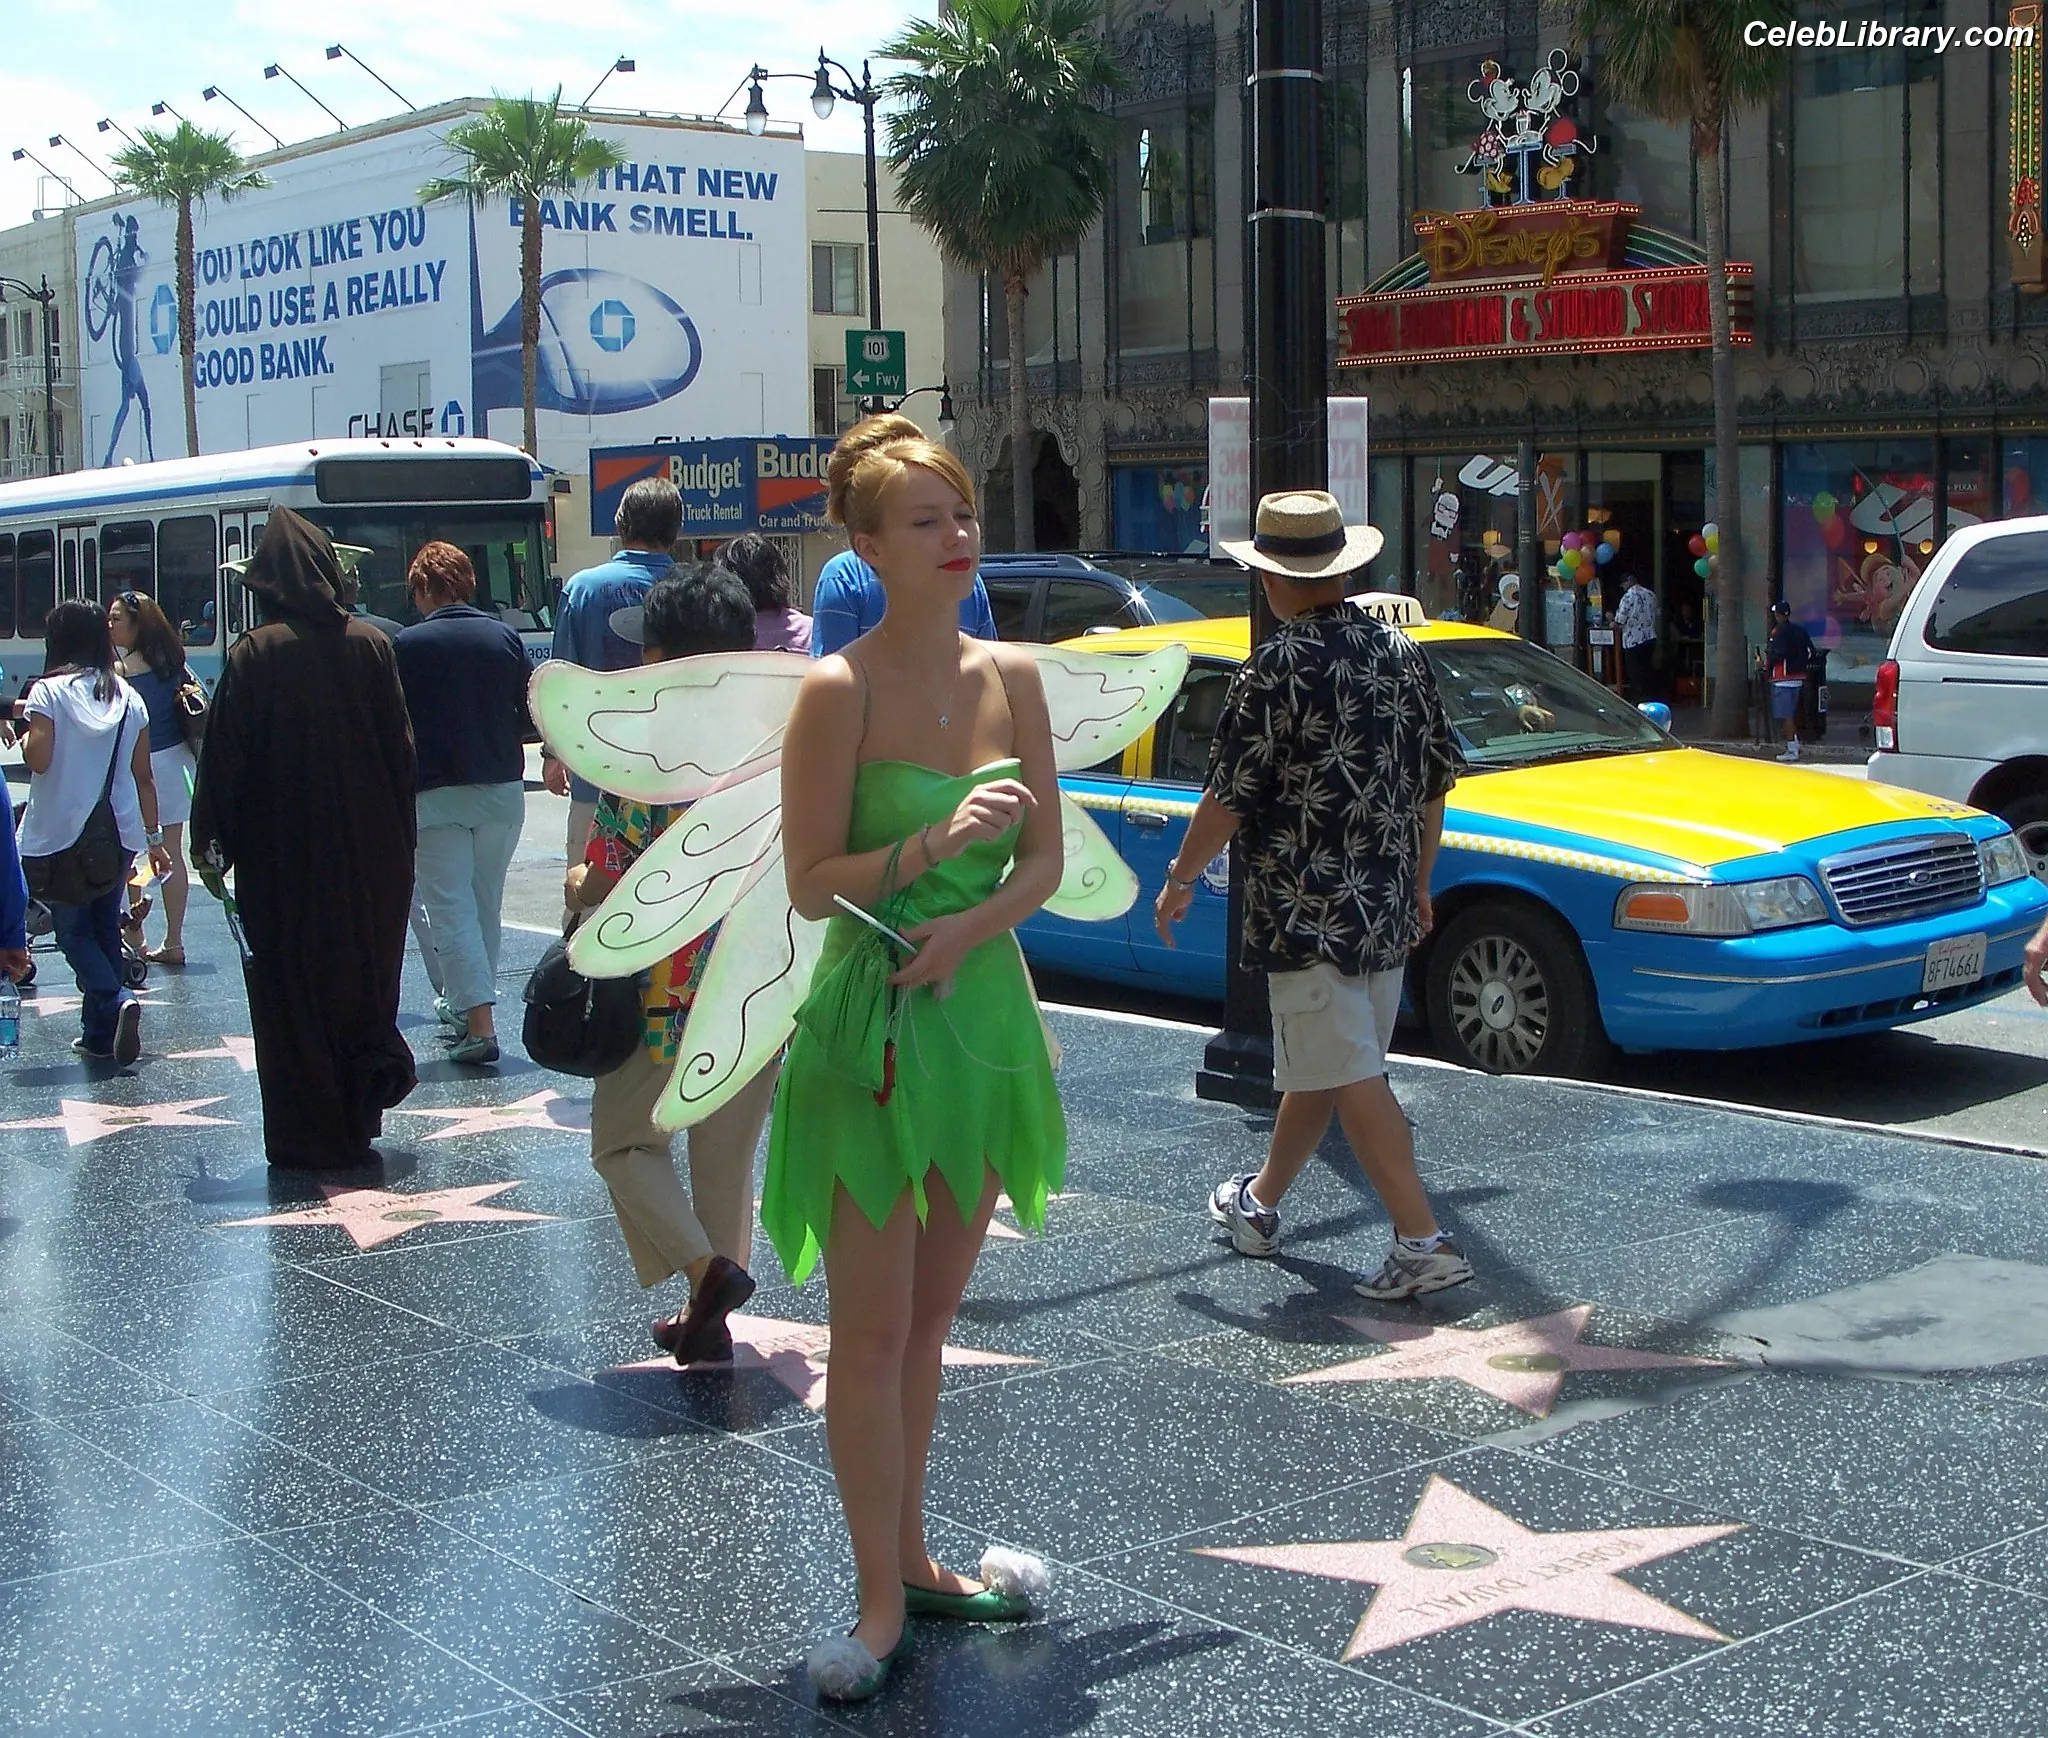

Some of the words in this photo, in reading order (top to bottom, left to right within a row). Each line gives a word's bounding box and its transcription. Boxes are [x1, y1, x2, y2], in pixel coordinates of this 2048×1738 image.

[697, 168, 778, 201] NEW
[509, 197, 617, 233] BANK
[628, 204, 753, 241] SMELL.
[238, 232, 302, 280] LOOK
[308, 218, 363, 268] LIKE
[367, 205, 426, 254] YOU
[269, 284, 316, 328] USE
[323, 281, 341, 322] A
[347, 260, 447, 317] REALLY
[1510, 297, 1533, 342] &
[1534, 284, 1628, 342] STUDIO
[193, 347, 255, 389] GOOD
[260, 335, 335, 381] BANK.
[868, 342, 885, 356] 101
[876, 371, 900, 390] Fwy
[348, 407, 434, 438] CHASE
[670, 453, 742, 498] Budget
[686, 503, 712, 521] Truck
[713, 502, 742, 521] Rental
[759, 514, 779, 528] Car
[781, 514, 801, 528] and
[1363, 603, 1410, 624] TAXI
[1927, 952, 1980, 983] 8F74661
[1529, 1539, 1644, 1581] ROBERT
[1397, 1577, 1527, 1617] DUVALL
